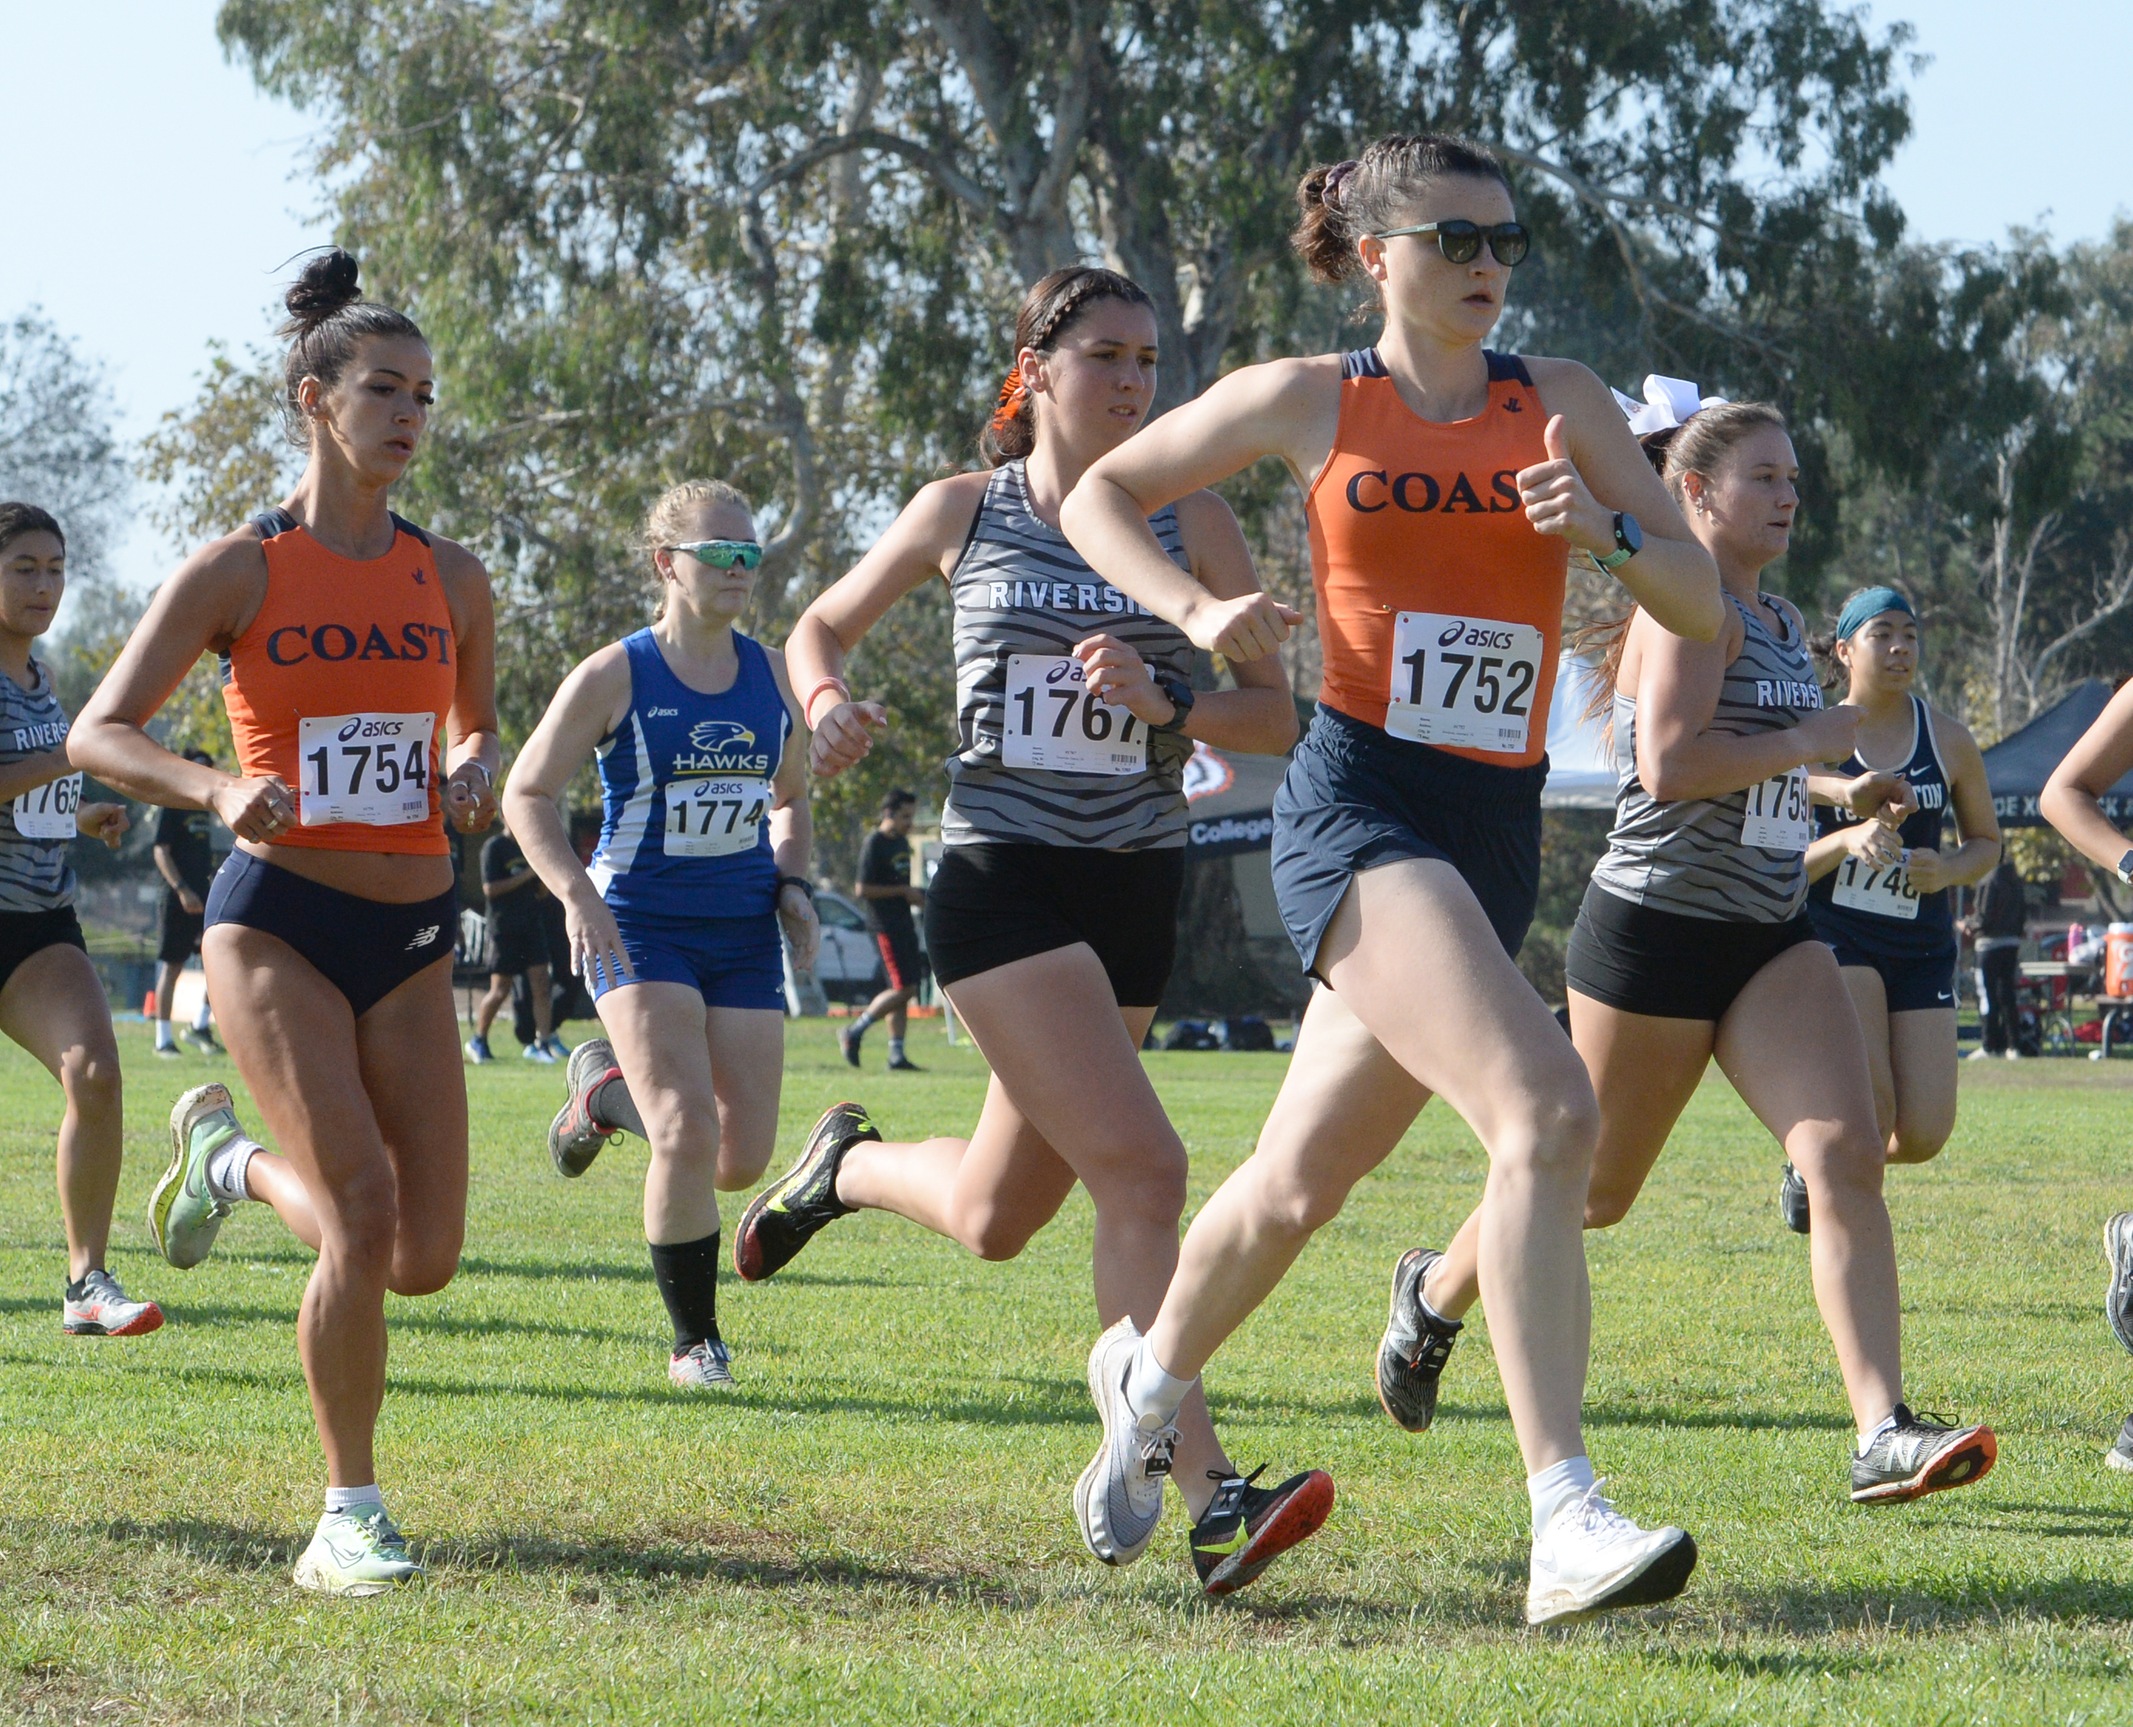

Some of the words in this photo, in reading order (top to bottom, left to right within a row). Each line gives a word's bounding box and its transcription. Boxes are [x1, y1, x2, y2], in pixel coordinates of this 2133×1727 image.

[1345, 469, 1521, 513] COAS
[266, 622, 450, 666] COAST
[1465, 628, 1514, 650] asics
[1402, 648, 1535, 717] 1752
[13, 722, 69, 751] RIVERS
[361, 721, 404, 738] asics
[307, 740, 427, 796] 1754
[672, 753, 769, 770] HAWKS
[711, 782, 743, 795] asics
[1755, 775, 1808, 823] 1759
[672, 798, 764, 835] 1774
